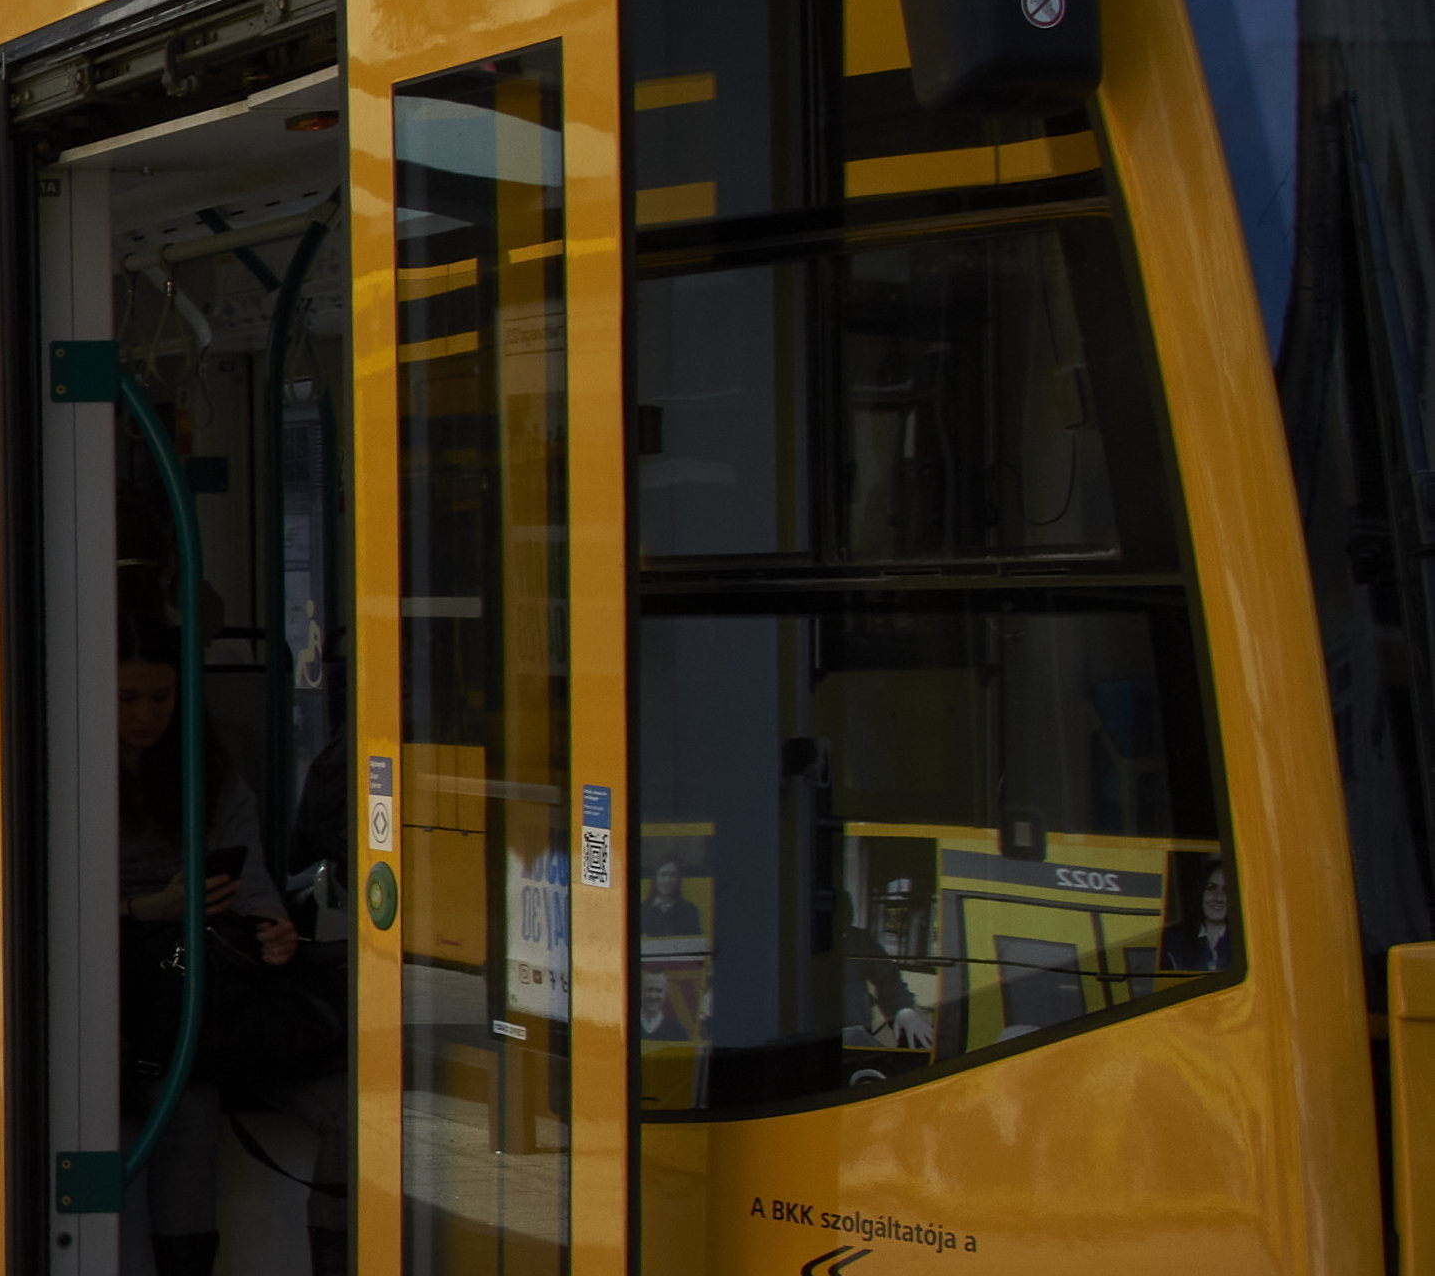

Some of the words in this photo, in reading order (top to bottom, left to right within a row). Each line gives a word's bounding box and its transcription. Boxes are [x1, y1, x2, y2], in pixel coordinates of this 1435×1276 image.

[750, 1197, 765, 1218] A
[772, 1200, 814, 1226] BKK
[820, 1211, 957, 1253] szolgáltatója
[964, 1234, 978, 1254] a
